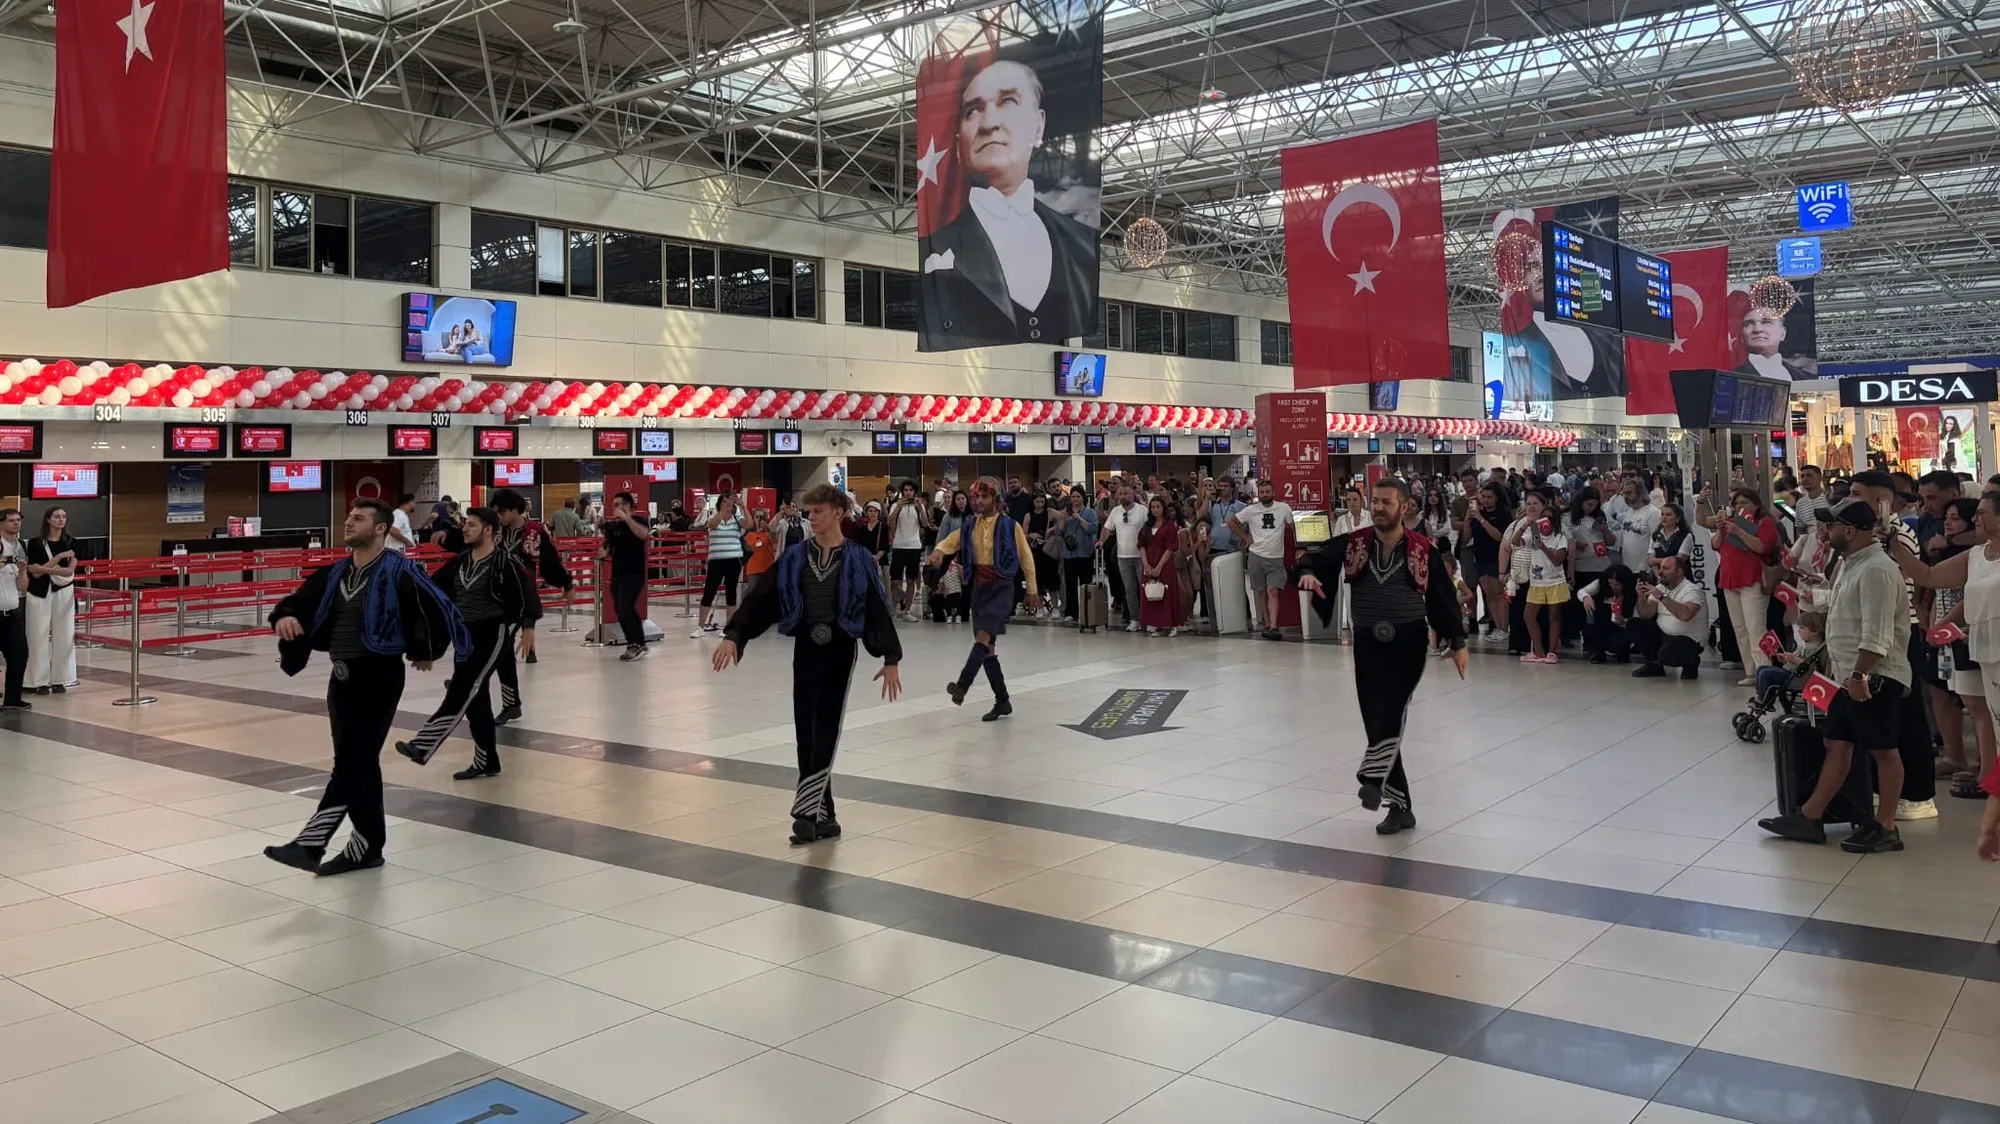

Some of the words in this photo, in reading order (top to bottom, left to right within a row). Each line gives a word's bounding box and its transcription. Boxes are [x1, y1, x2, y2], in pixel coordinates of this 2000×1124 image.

[1800, 184, 1843, 202] WiFi
[1859, 376, 1974, 403] DESA
[96, 405, 121, 421] 304
[203, 407, 226, 422] 305
[348, 411, 367, 424] 306
[432, 413, 450, 426] 307
[580, 416, 595, 428] 308
[642, 416, 657, 428] 309
[733, 418, 747, 429] 310
[786, 419, 798, 429] 311
[862, 421, 874, 430] 312
[923, 421, 934, 431] 313
[1282, 443, 1290, 457] 1
[1284, 483, 1293, 498] 2
